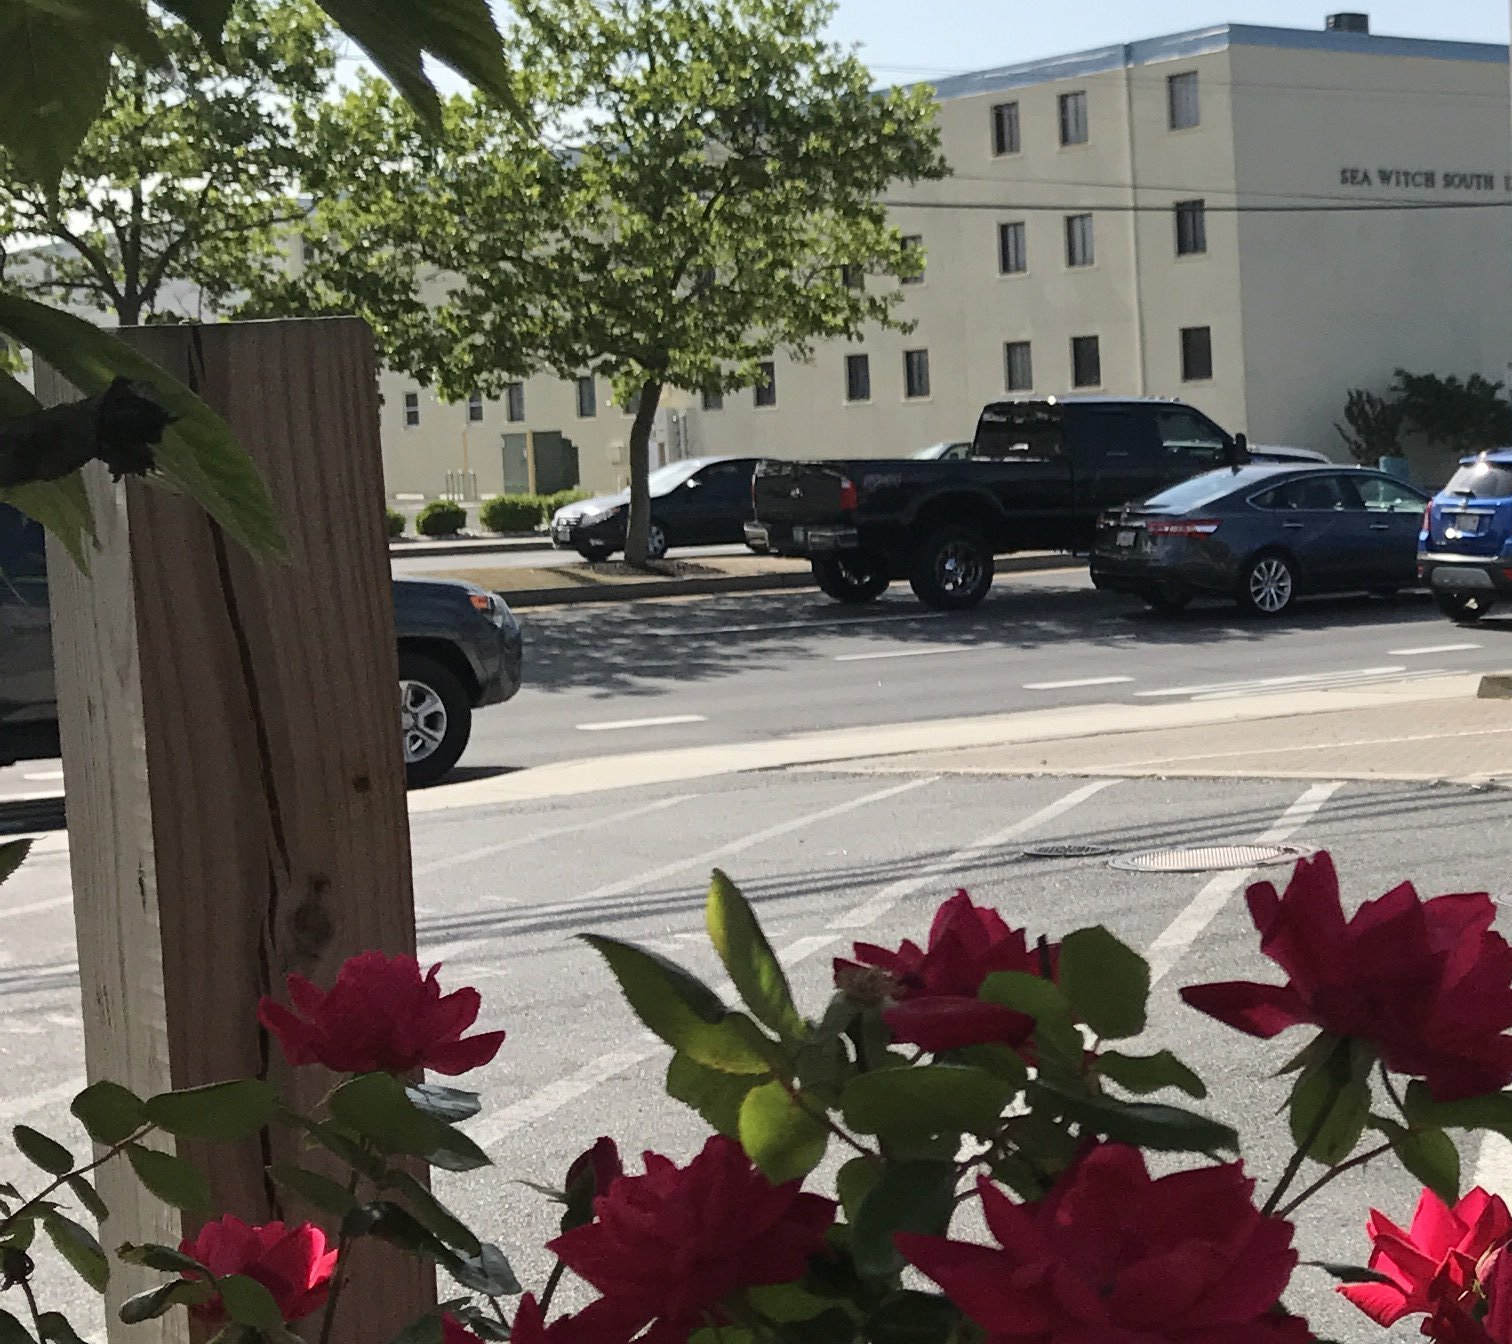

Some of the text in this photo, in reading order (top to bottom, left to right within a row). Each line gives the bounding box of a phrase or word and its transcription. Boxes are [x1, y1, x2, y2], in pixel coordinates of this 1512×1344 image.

[1340, 168, 1372, 187] SEA
[1378, 169, 1436, 189] WITCH
[1443, 172, 1494, 191] SOUTH
